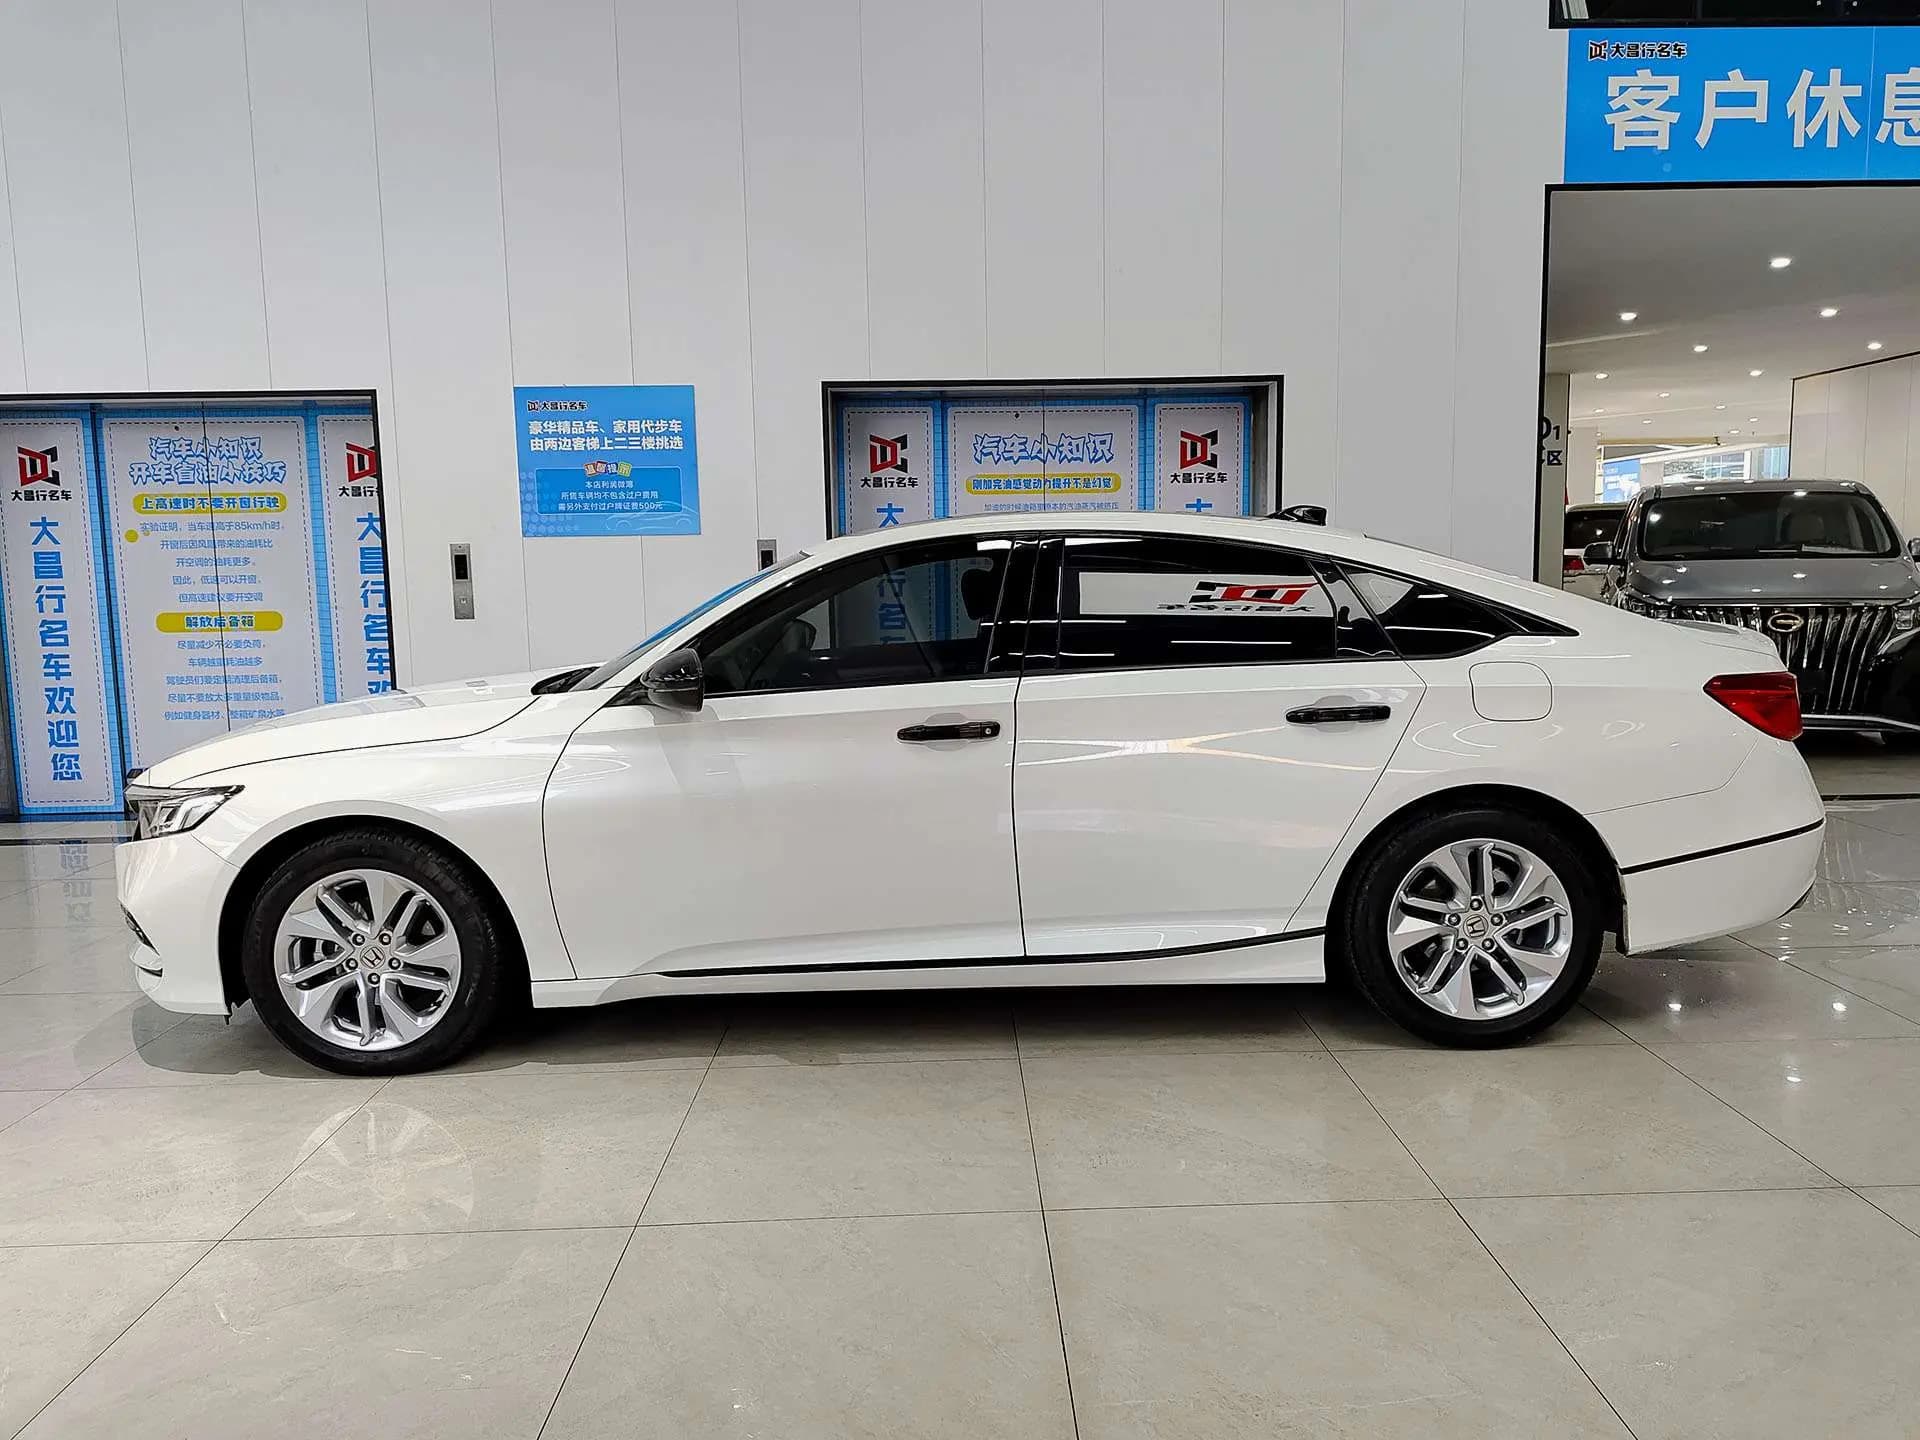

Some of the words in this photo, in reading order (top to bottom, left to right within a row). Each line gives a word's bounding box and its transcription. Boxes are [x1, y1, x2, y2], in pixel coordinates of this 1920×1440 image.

[1610, 42, 1687, 58] 大昌行名车
[541, 401, 587, 411] 大昌行名车
[528, 420, 683, 435] 豪华精品车、家用代步车
[150, 436, 262, 460] 汽车小知识
[530, 437, 683, 450] 由两边客梯上二三楼挑选
[973, 433, 1114, 465] 汽车小知识
[129, 461, 287, 485] 开车省油小技巧
[1170, 472, 1228, 484] 大昌行名车
[860, 477, 919, 488] 大昌行名车
[972, 477, 1112, 490] 刚加完油感觉动力提升不是幻觉
[11, 489, 72, 501] 大昌行名车
[338, 485, 379, 498] 大昌行
[142, 496, 280, 510] 上高速时不要开窗行驶
[185, 616, 254, 628] 解放后备箱
[30, 516, 83, 781] 大昌行名车欢迎您
